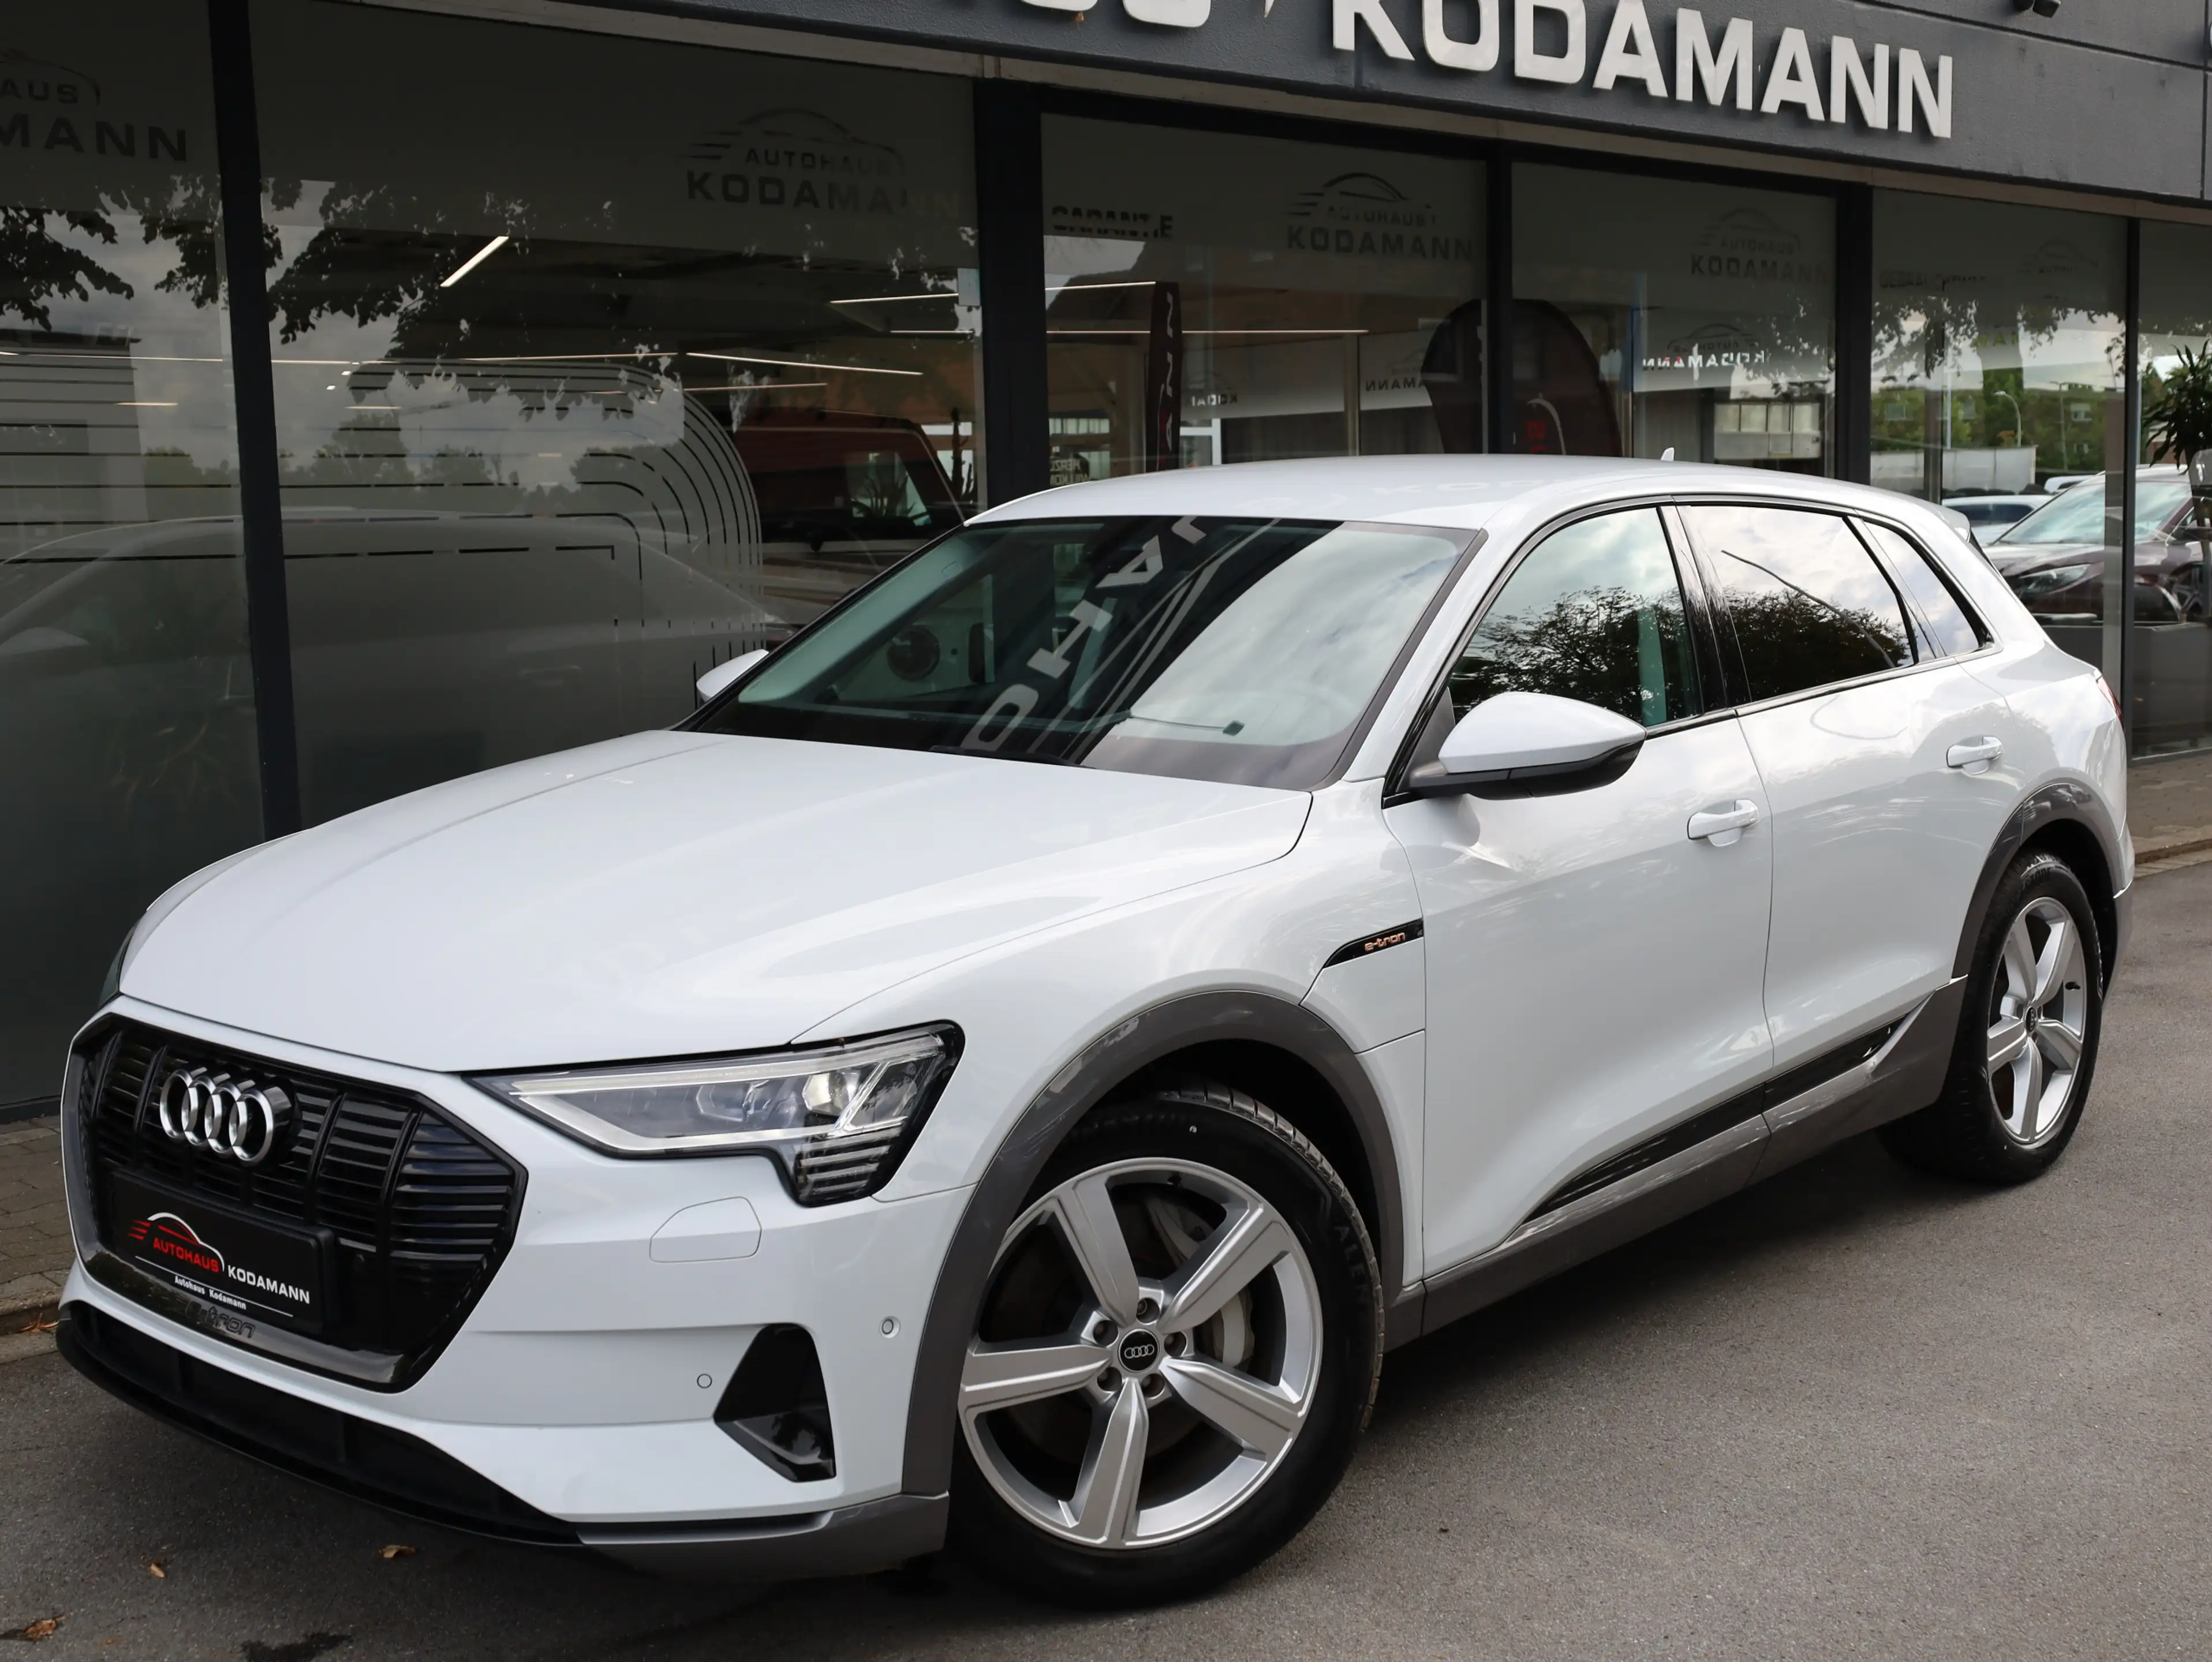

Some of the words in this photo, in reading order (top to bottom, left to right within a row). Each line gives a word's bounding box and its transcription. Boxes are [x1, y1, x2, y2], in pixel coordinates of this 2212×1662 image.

[1333, 0, 1953, 139] KODAMANN
[745, 147, 892, 175] AUTOHAUS
[686, 170, 959, 218] KODAMANN
[1328, 205, 1426, 227] AUTOHAUS
[1287, 224, 1471, 261] KODAMANN
[1690, 253, 1831, 284] KODAMANN
[1365, 932, 1406, 951] e-tron
[153, 1237, 219, 1273] AUTOHAUS
[227, 1264, 310, 1304] KODAMANN
[175, 1275, 205, 1294] Autohaus
[209, 1289, 246, 1310] Kodamann
